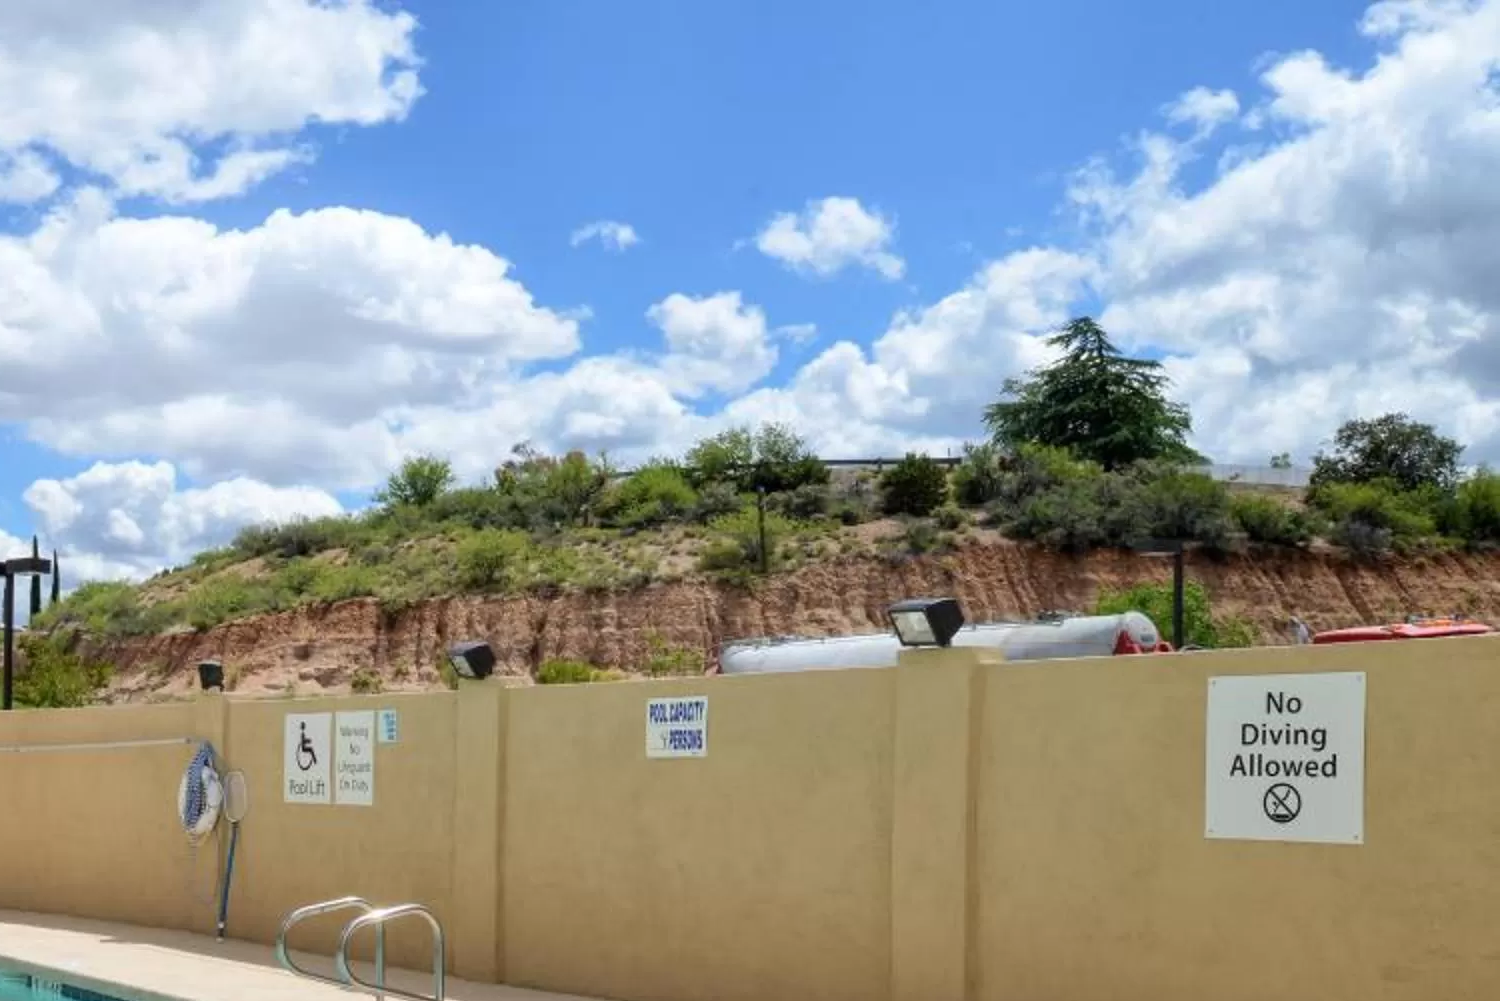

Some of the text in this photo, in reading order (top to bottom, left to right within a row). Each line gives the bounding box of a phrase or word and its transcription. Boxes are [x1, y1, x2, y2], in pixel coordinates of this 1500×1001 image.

[650, 701, 705, 723] POOL CAPACITY
[1266, 691, 1302, 714] No
[670, 730, 703, 750] PERSONS
[1241, 723, 1327, 752] Diving
[1229, 753, 1337, 778] Allowed
[289, 779, 325, 797] Pool Lift
